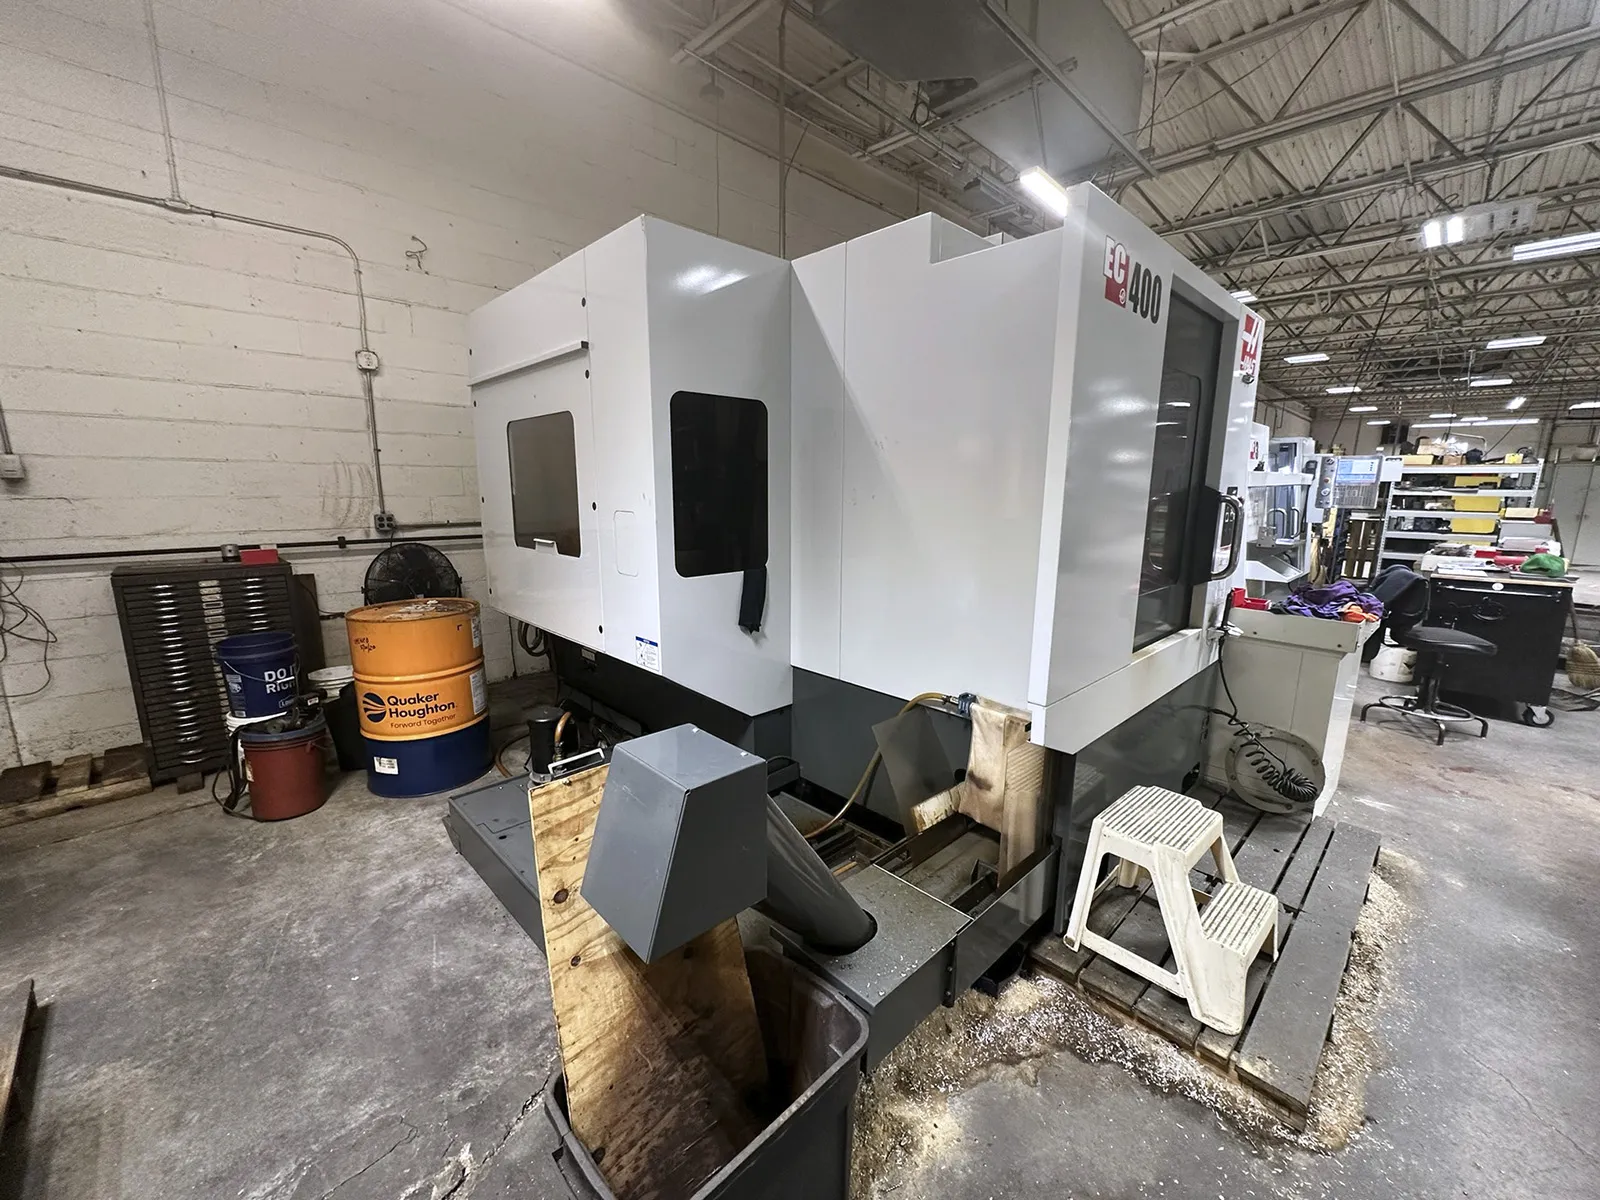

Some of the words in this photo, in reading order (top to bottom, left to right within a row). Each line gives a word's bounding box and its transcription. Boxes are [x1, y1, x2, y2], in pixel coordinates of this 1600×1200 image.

[1103, 235, 1127, 284] EC
[1128, 262, 1162, 324] 400
[264, 667, 287, 682] DO
[387, 692, 439, 706] Quaker
[389, 701, 455, 718] Houghton
[390, 721, 422, 729] Forward
[424, 714, 456, 726] Together
